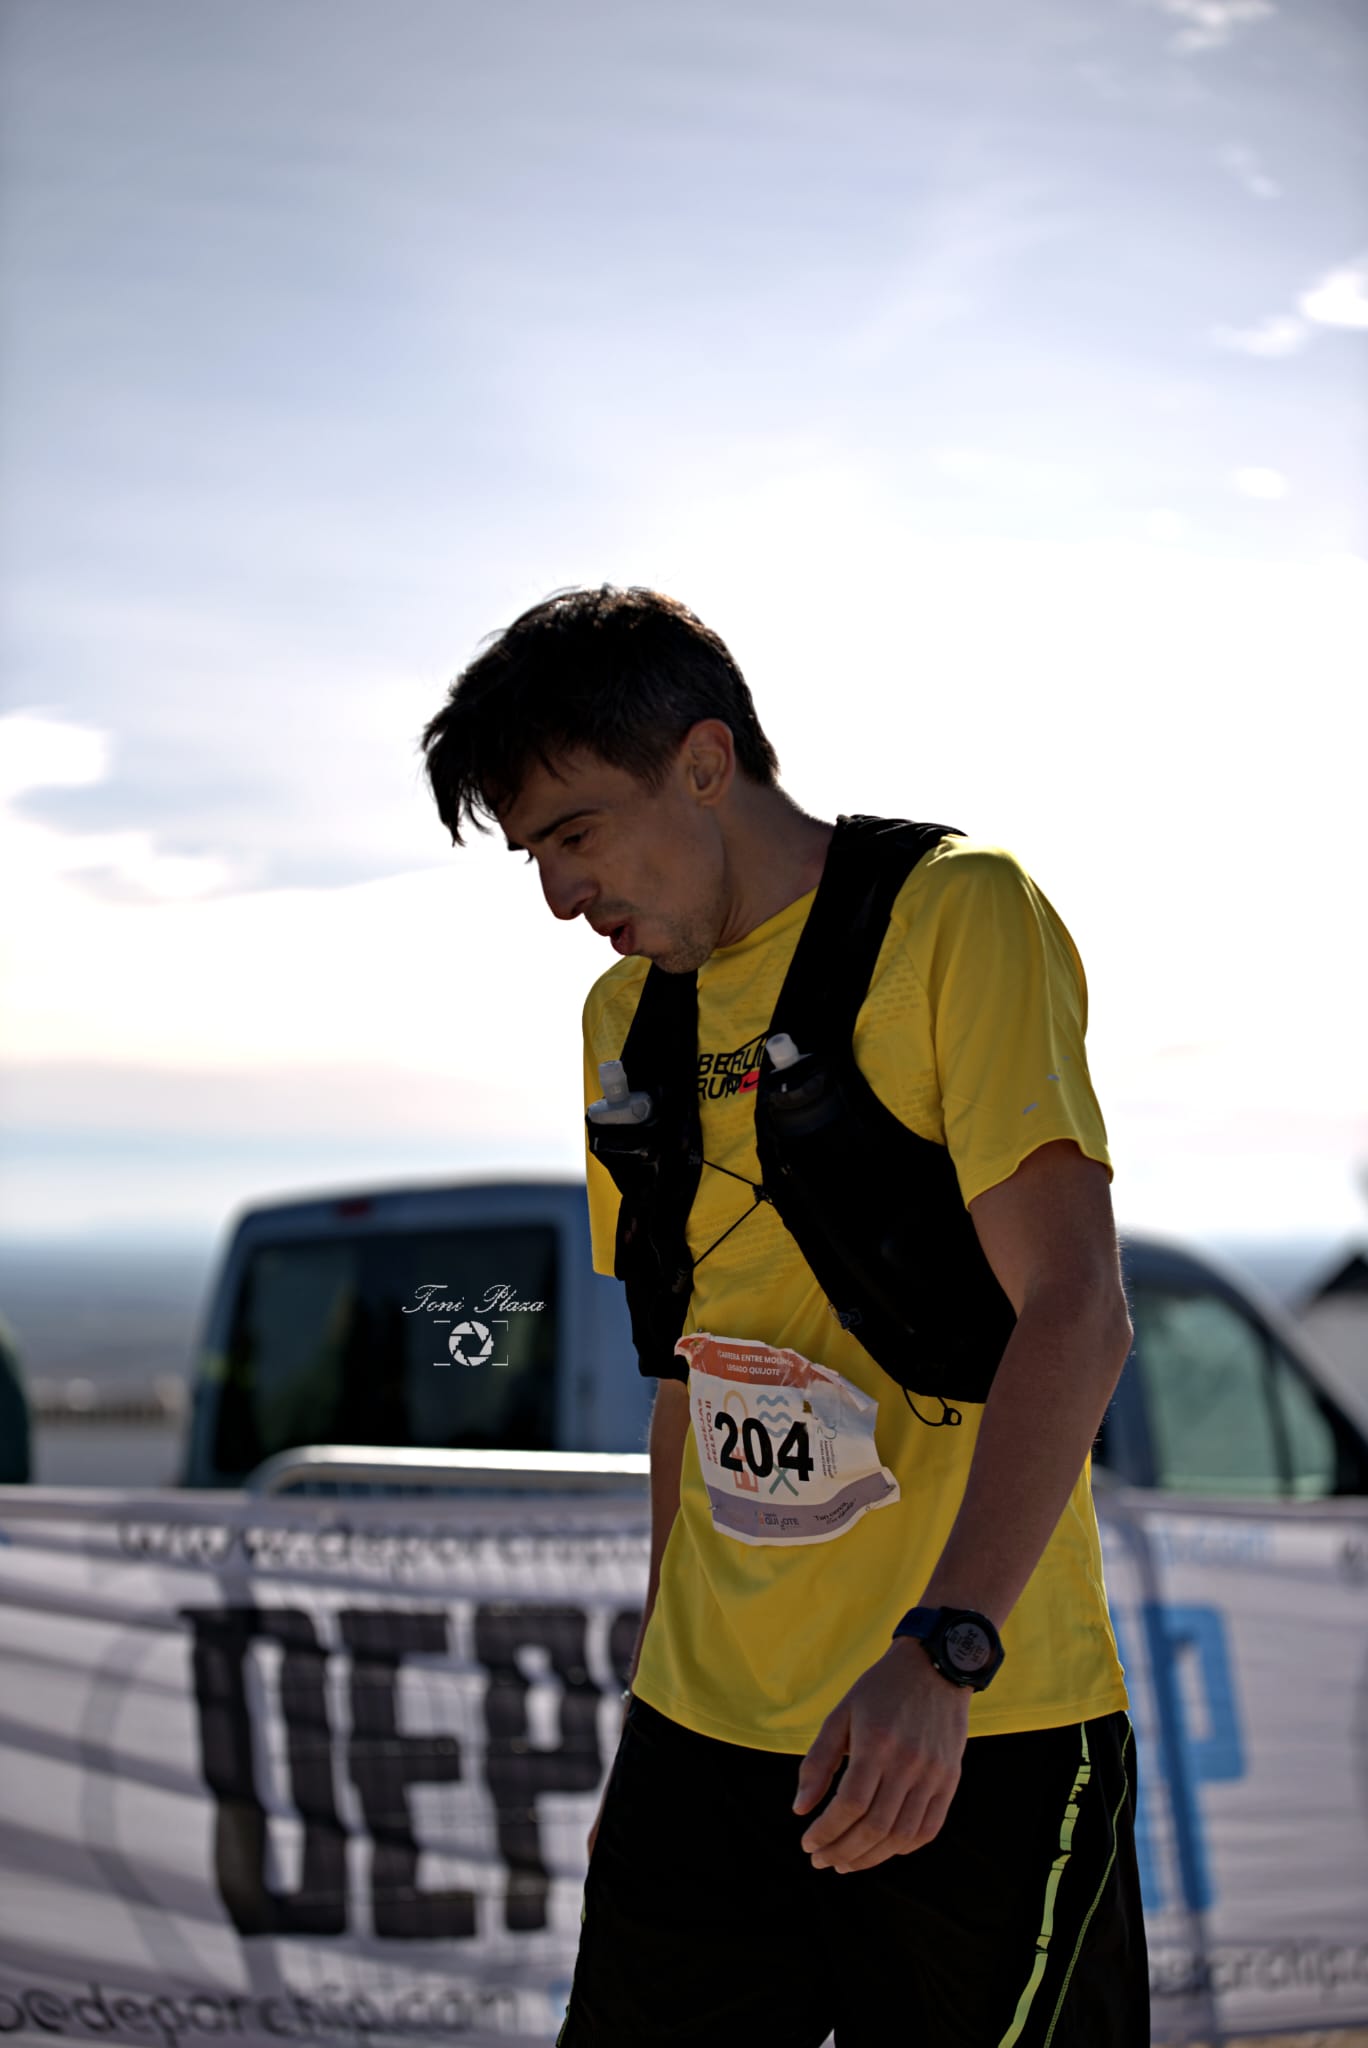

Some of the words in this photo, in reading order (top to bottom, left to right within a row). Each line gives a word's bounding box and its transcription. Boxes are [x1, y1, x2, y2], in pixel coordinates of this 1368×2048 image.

[740, 1353, 764, 1363] ENTRE
[748, 1366, 780, 1377] QUIJOTE
[714, 1411, 814, 1482] 204
[178, 1606, 641, 1938] DEP
